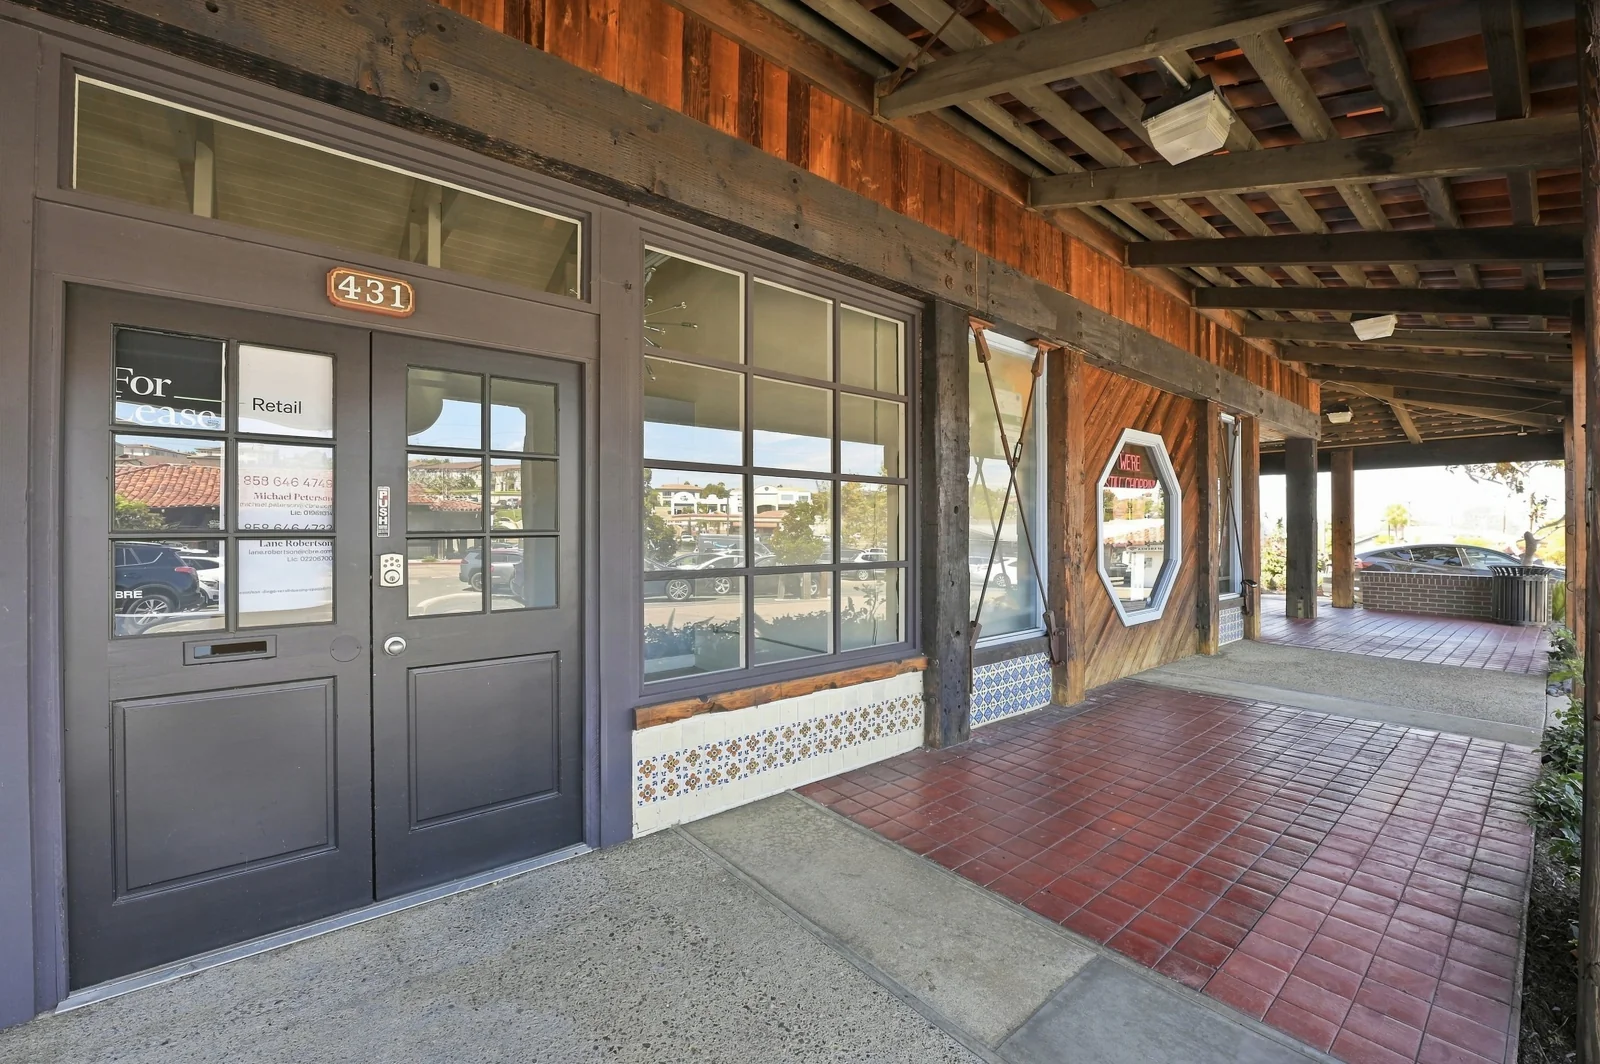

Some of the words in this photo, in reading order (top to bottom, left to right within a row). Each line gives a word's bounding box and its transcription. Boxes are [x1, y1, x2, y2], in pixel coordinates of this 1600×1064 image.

[338, 275, 405, 309] 431
[115, 366, 172, 398] For
[252, 397, 302, 415] Retail
[243, 475, 269, 487] 858
[273, 476, 299, 488] 646
[253, 492, 292, 501] Michael
[379, 490, 388, 525] PUSH
[259, 539, 283, 548] Lane
[285, 539, 333, 548] Robertson
